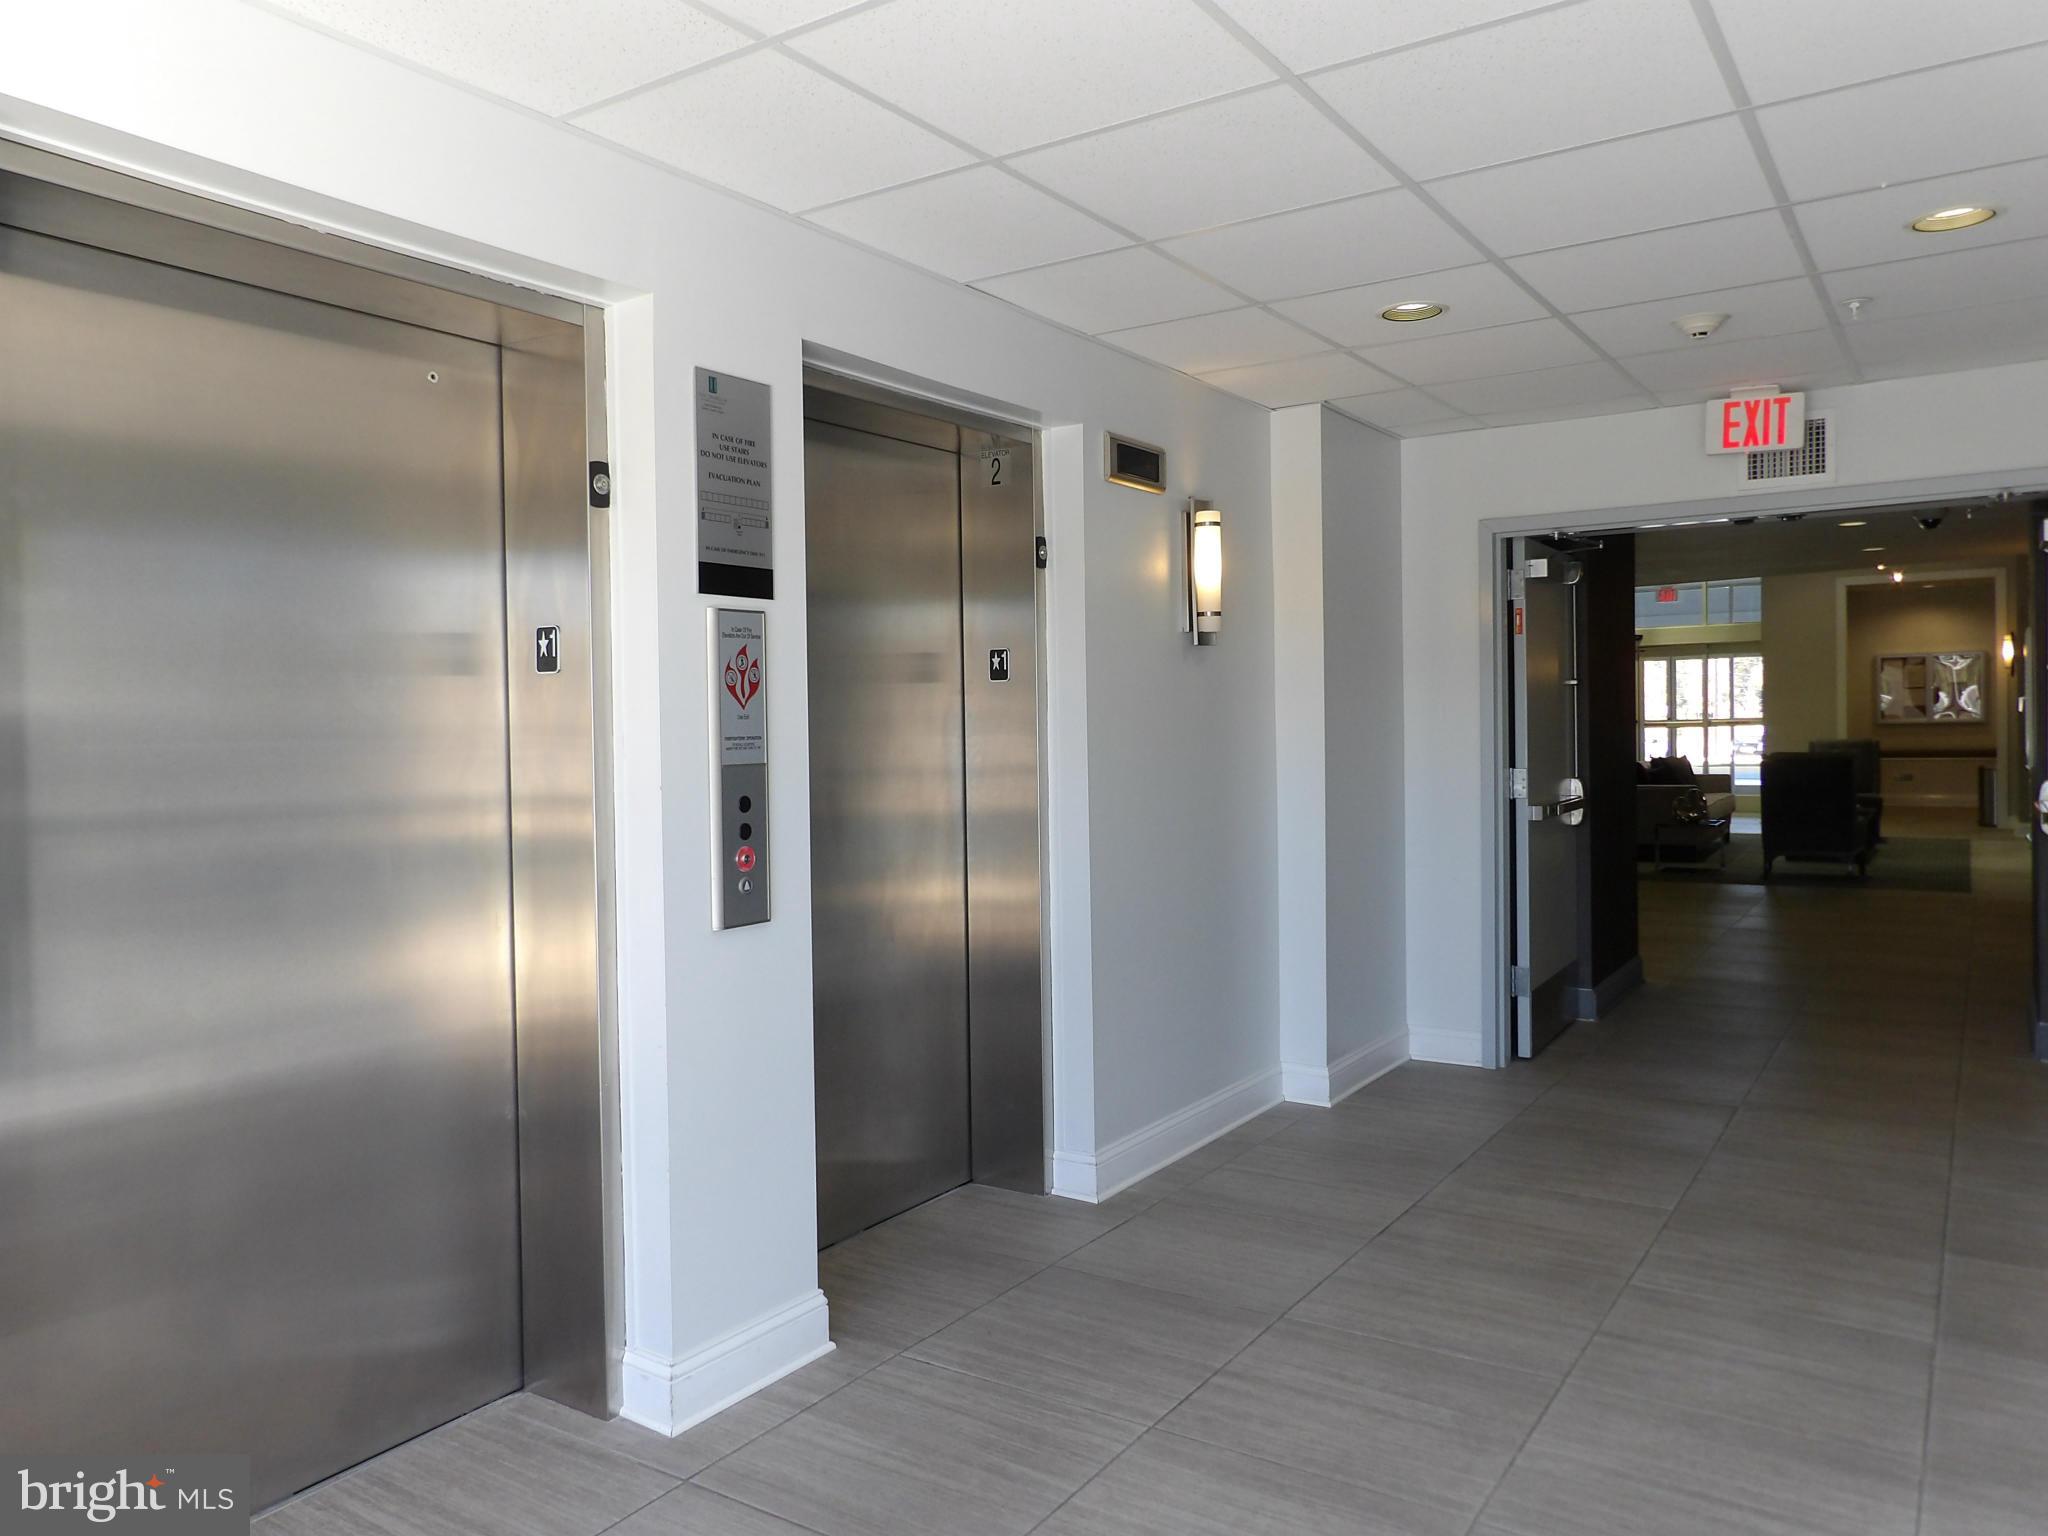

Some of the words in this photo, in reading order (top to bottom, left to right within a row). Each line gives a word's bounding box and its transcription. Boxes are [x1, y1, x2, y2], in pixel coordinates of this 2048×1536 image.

[1722, 397, 1792, 449] EXIT
[712, 432, 719, 440] IN
[720, 434, 734, 443] CASE
[735, 437, 744, 445] OF
[719, 443, 730, 451] USE
[731, 446, 750, 455] STAIRS
[981, 449, 1010, 459] ELEVATOR
[700, 449, 711, 457] DO
[711, 451, 724, 460] NOT
[725, 455, 737, 463] USE
[737, 457, 767, 469] ELEVATORS
[708, 471, 746, 484] EVACUATION
[746, 479, 761, 487] PLAN
[991, 457, 1001, 486] 2
[549, 629, 556, 657] 1
[1001, 651, 1007, 670] 1
